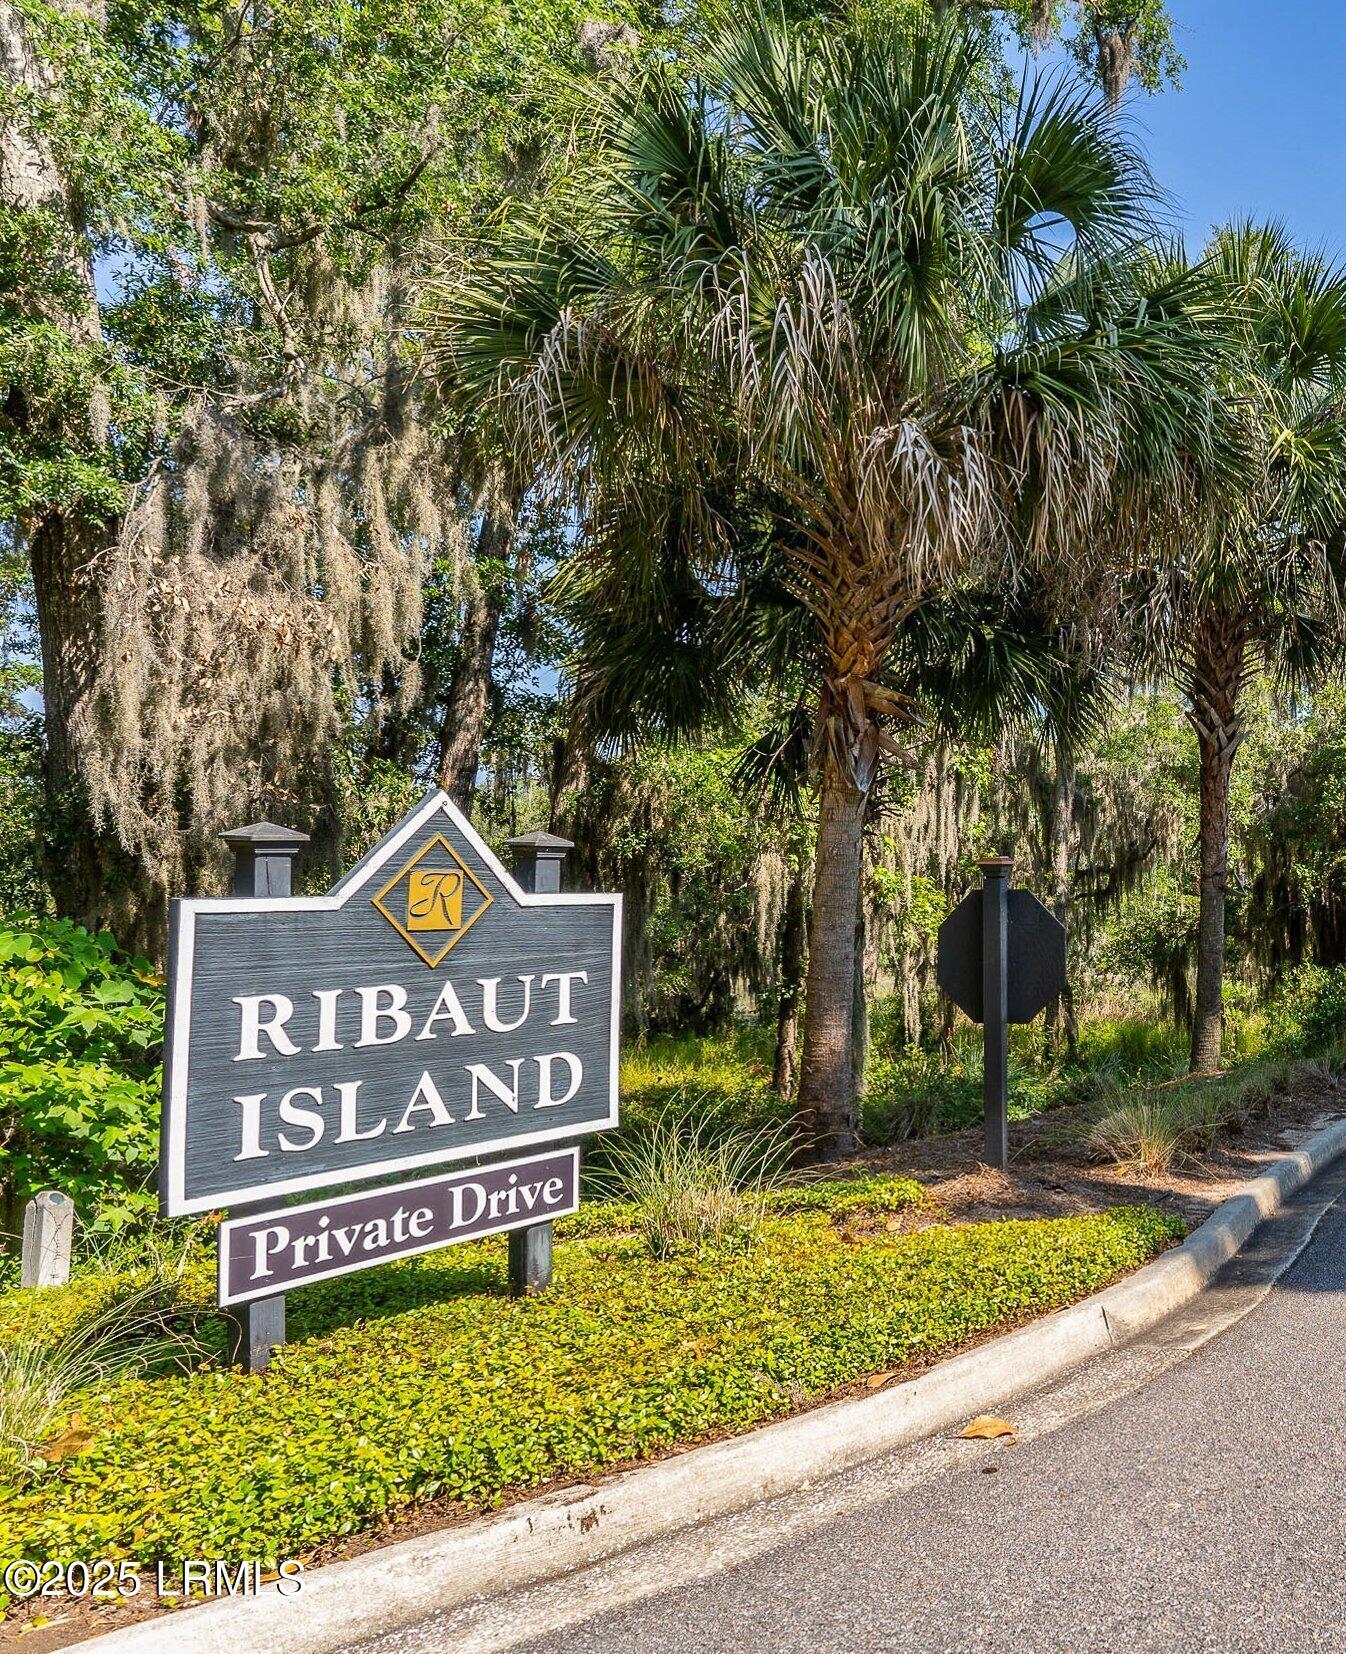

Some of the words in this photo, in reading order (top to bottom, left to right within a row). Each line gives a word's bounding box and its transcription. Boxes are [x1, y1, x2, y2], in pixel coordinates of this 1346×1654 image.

[410, 872, 461, 926] R
[232, 970, 588, 1062] RIBAUT
[232, 1052, 583, 1162] ISLAND
[249, 1205, 434, 1280] Private
[448, 1174, 564, 1230] Drive
